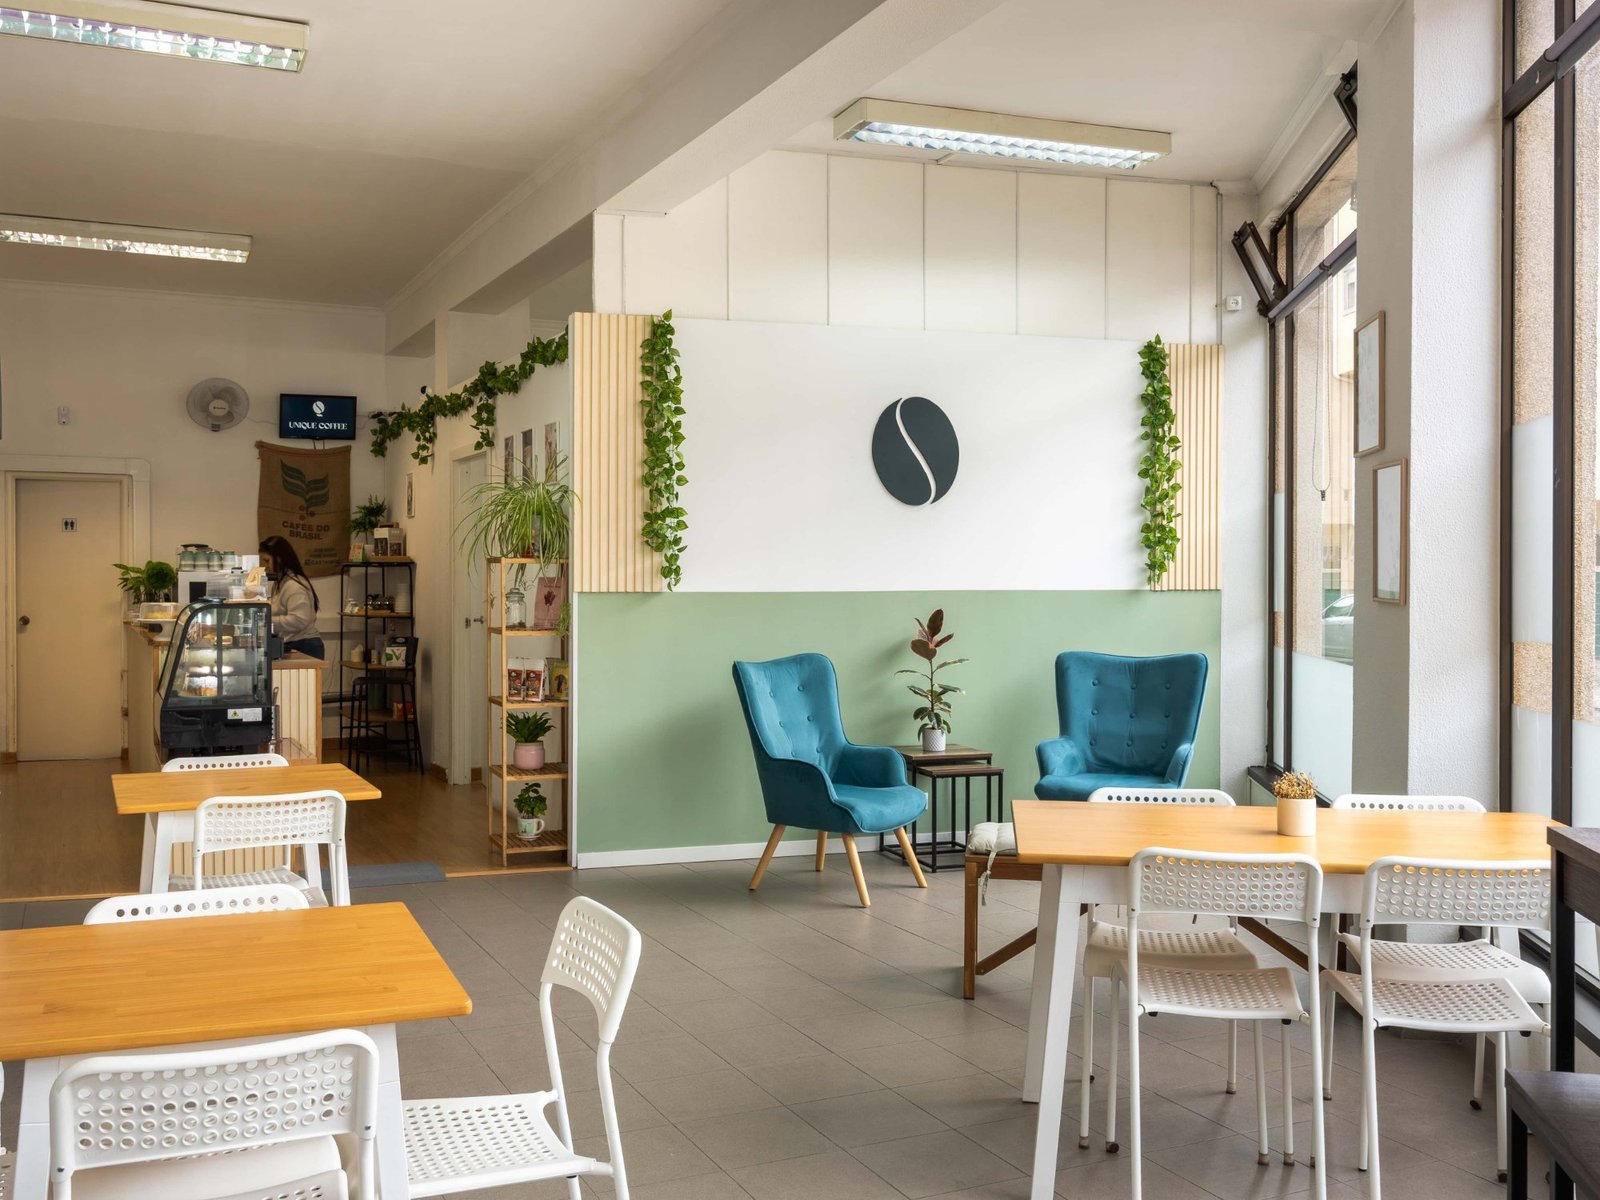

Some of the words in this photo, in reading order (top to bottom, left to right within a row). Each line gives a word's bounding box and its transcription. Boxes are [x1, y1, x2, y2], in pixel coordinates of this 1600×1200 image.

[288, 421, 317, 430] UNIQUE
[318, 422, 348, 430] COFFEE
[316, 524, 331, 532] DO
[289, 530, 324, 540] BRASIL
